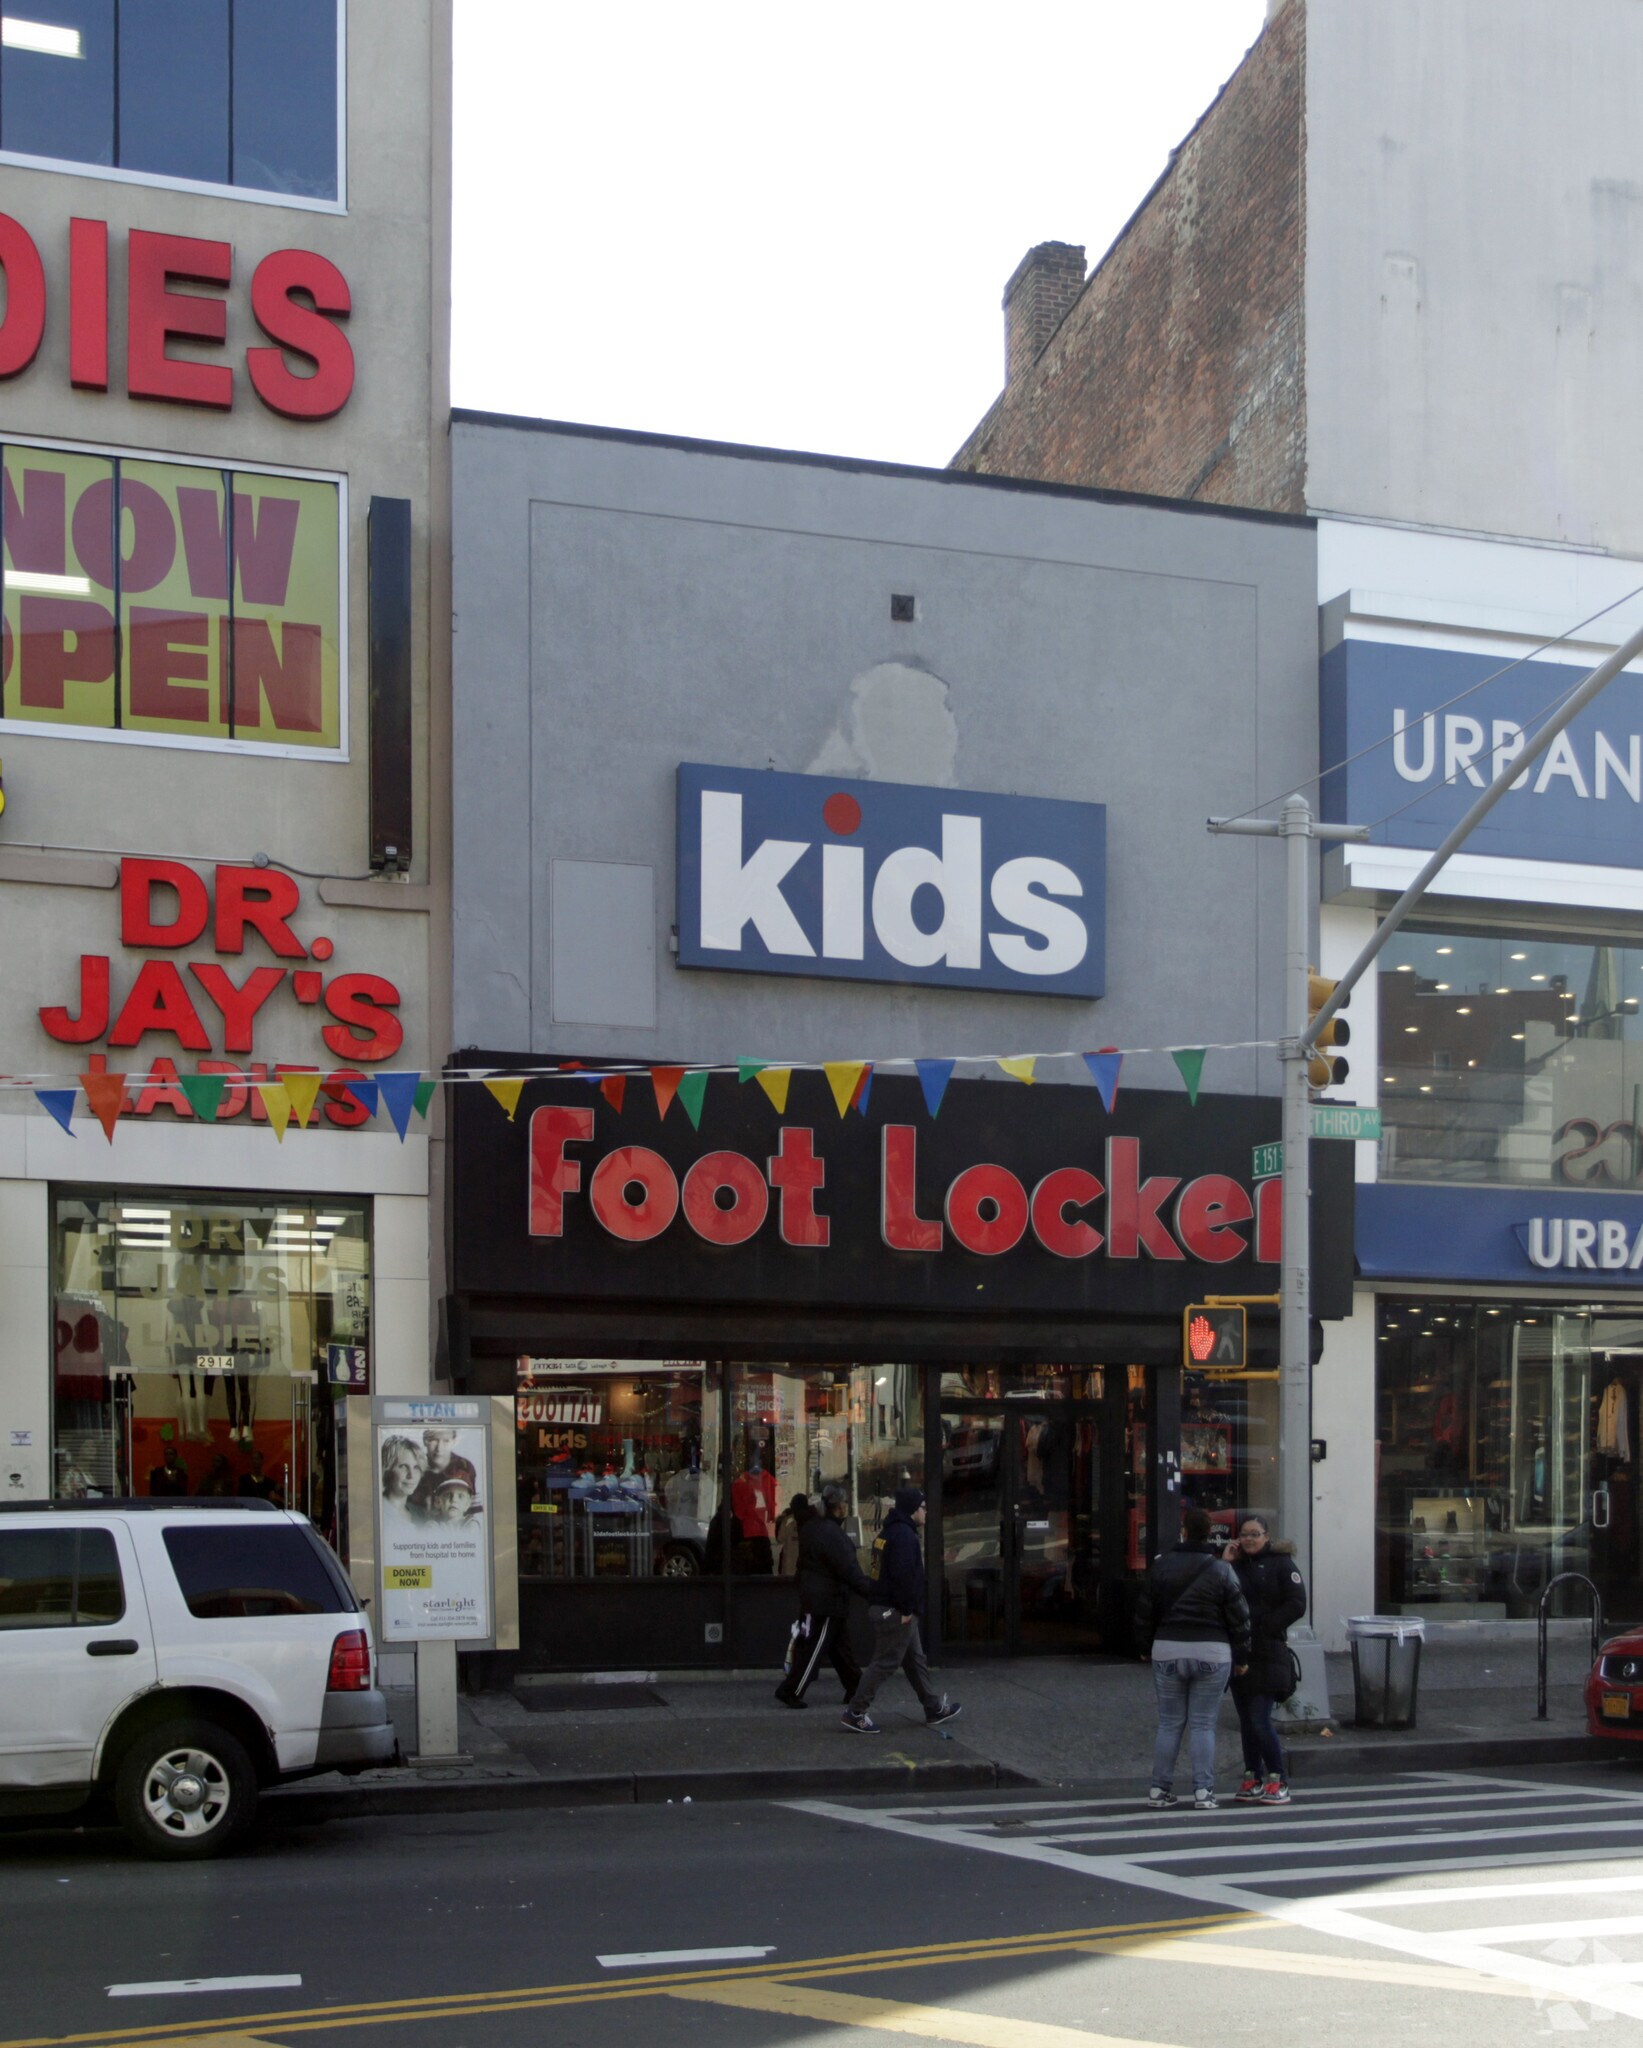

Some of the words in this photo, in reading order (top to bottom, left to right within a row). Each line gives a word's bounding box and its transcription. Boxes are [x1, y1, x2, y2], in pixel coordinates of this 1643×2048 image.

[2, 594, 322, 733] PEN
[1393, 708, 1641, 804] URBAN
[700, 790, 1088, 976] kids
[121, 857, 334, 961] DR.
[38, 954, 403, 1063] JAY'S
[1313, 1109, 1361, 1136] THIRD
[1364, 1113, 1378, 1125] AV
[1254, 1150, 1259, 1175] E
[1263, 1147, 1277, 1172] 151
[528, 1105, 830, 1248] Foot
[140, 1262, 288, 1303] JAY'S
[142, 1322, 286, 1350] LADIES
[198, 1356, 233, 1367] 2914
[408, 1403, 456, 1417] TITAN
[538, 1429, 588, 1449] kids
[393, 1542, 426, 1551] Supporting
[453, 1541, 476, 1549] families
[425, 1551, 449, 1560] hospital
[392, 1568, 426, 1577] DONATE
[399, 1579, 420, 1587] NOW
